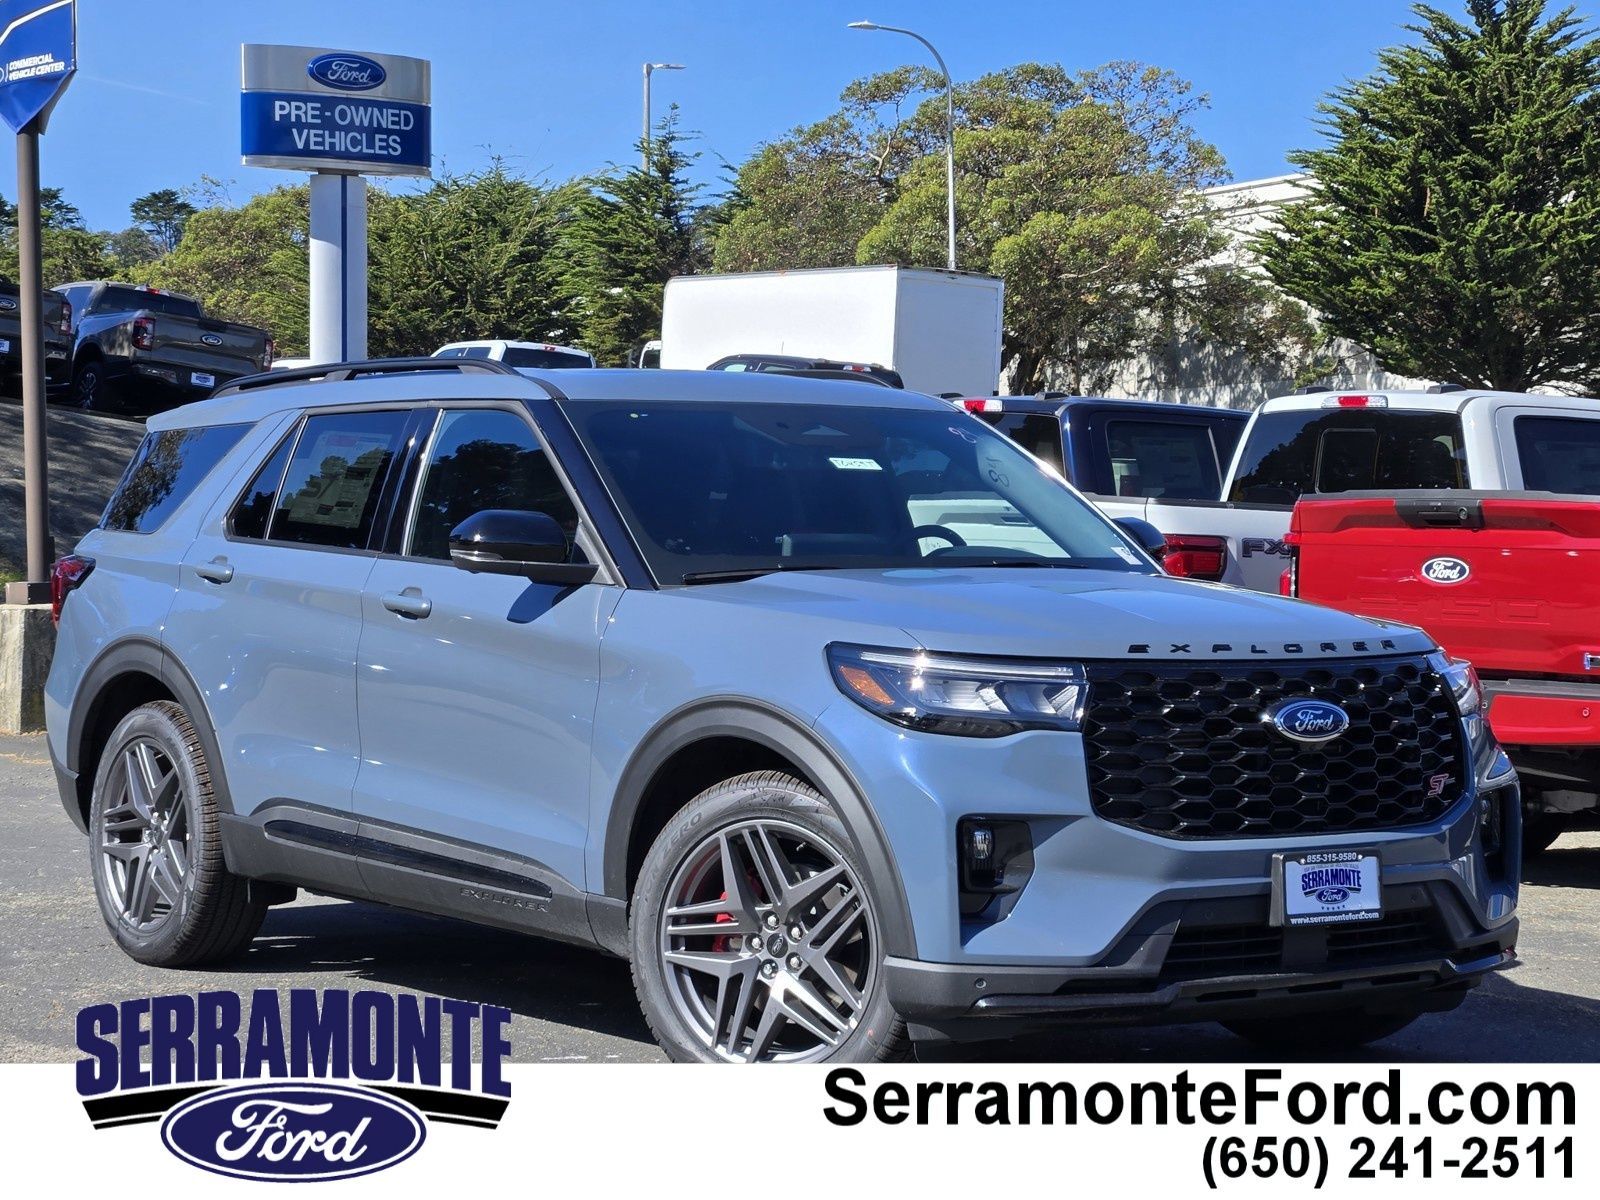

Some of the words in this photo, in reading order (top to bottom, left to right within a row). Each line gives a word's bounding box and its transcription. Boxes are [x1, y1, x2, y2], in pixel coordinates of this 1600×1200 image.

[35, 61, 65, 75] CENTER
[327, 60, 371, 83] Ford
[292, 129, 402, 156] VEHICLES
[1428, 559, 1460, 580] Ford
[1127, 638, 1396, 653] EXPLORER
[1294, 708, 1334, 732] Ford
[1427, 773, 1449, 796] ST
[1306, 852, 1357, 863] 855-315-9580
[1301, 868, 1362, 891] SERRAMONTE
[460, 888, 548, 913] EXPLORER
[1321, 888, 1343, 902] Ford
[1290, 911, 1380, 925] www.serramonteford.com
